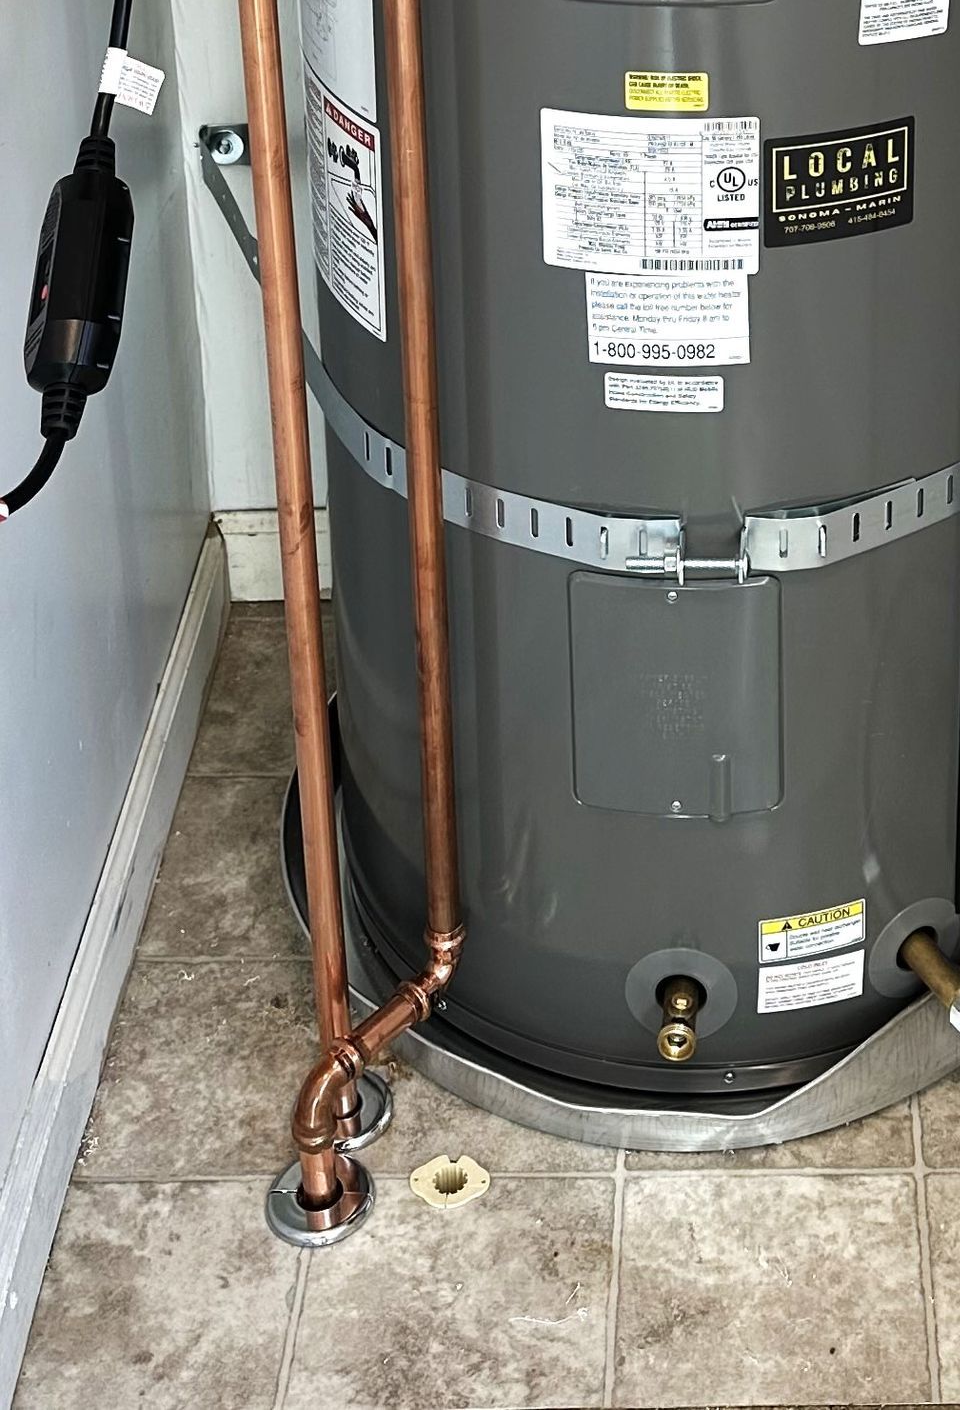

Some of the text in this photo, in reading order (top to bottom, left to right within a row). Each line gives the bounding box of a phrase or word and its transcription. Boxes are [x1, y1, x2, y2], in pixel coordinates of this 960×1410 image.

[333, 109, 371, 147] DANGER
[784, 139, 900, 181] LOCAL
[724, 172, 738, 187] UL
[786, 169, 898, 202] PLUMBING
[717, 194, 745, 202] LISTED
[779, 209, 840, 222] SONOMA
[856, 196, 901, 211] MARIN
[723, 279, 735, 287] the
[592, 302, 615, 310] please
[616, 302, 628, 310] call
[594, 342, 716, 360] 1-800-995-0982
[798, 907, 850, 927] CAUTION
